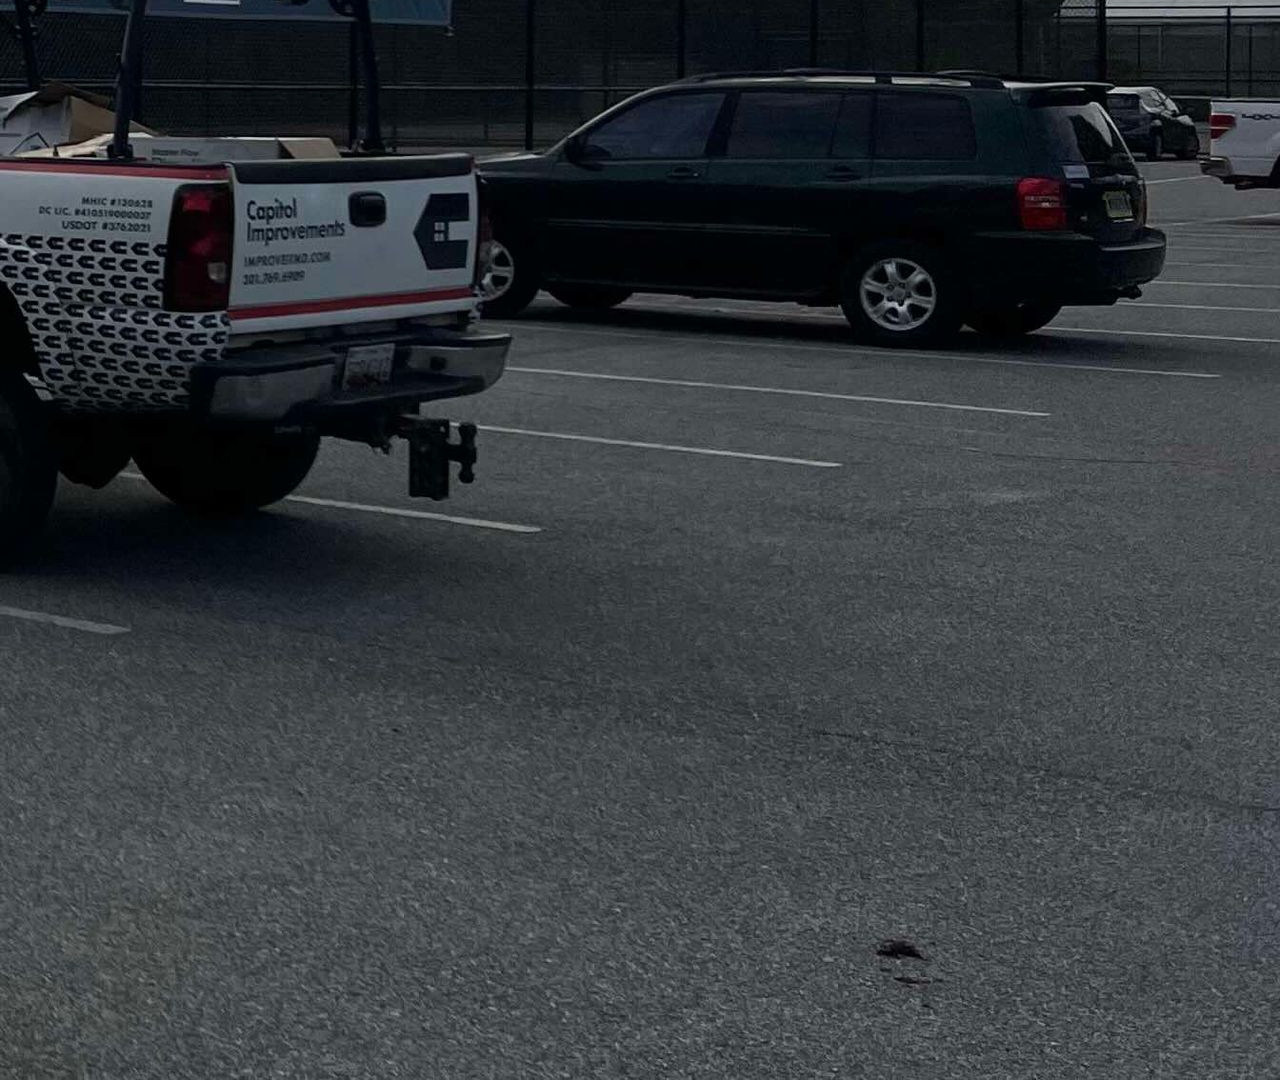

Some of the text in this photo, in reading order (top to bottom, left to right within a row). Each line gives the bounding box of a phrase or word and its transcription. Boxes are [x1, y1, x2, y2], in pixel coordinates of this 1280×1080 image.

[247, 199, 297, 225] Capitol
[62, 220, 97, 230] USDOT
[247, 221, 345, 246] Improvements
